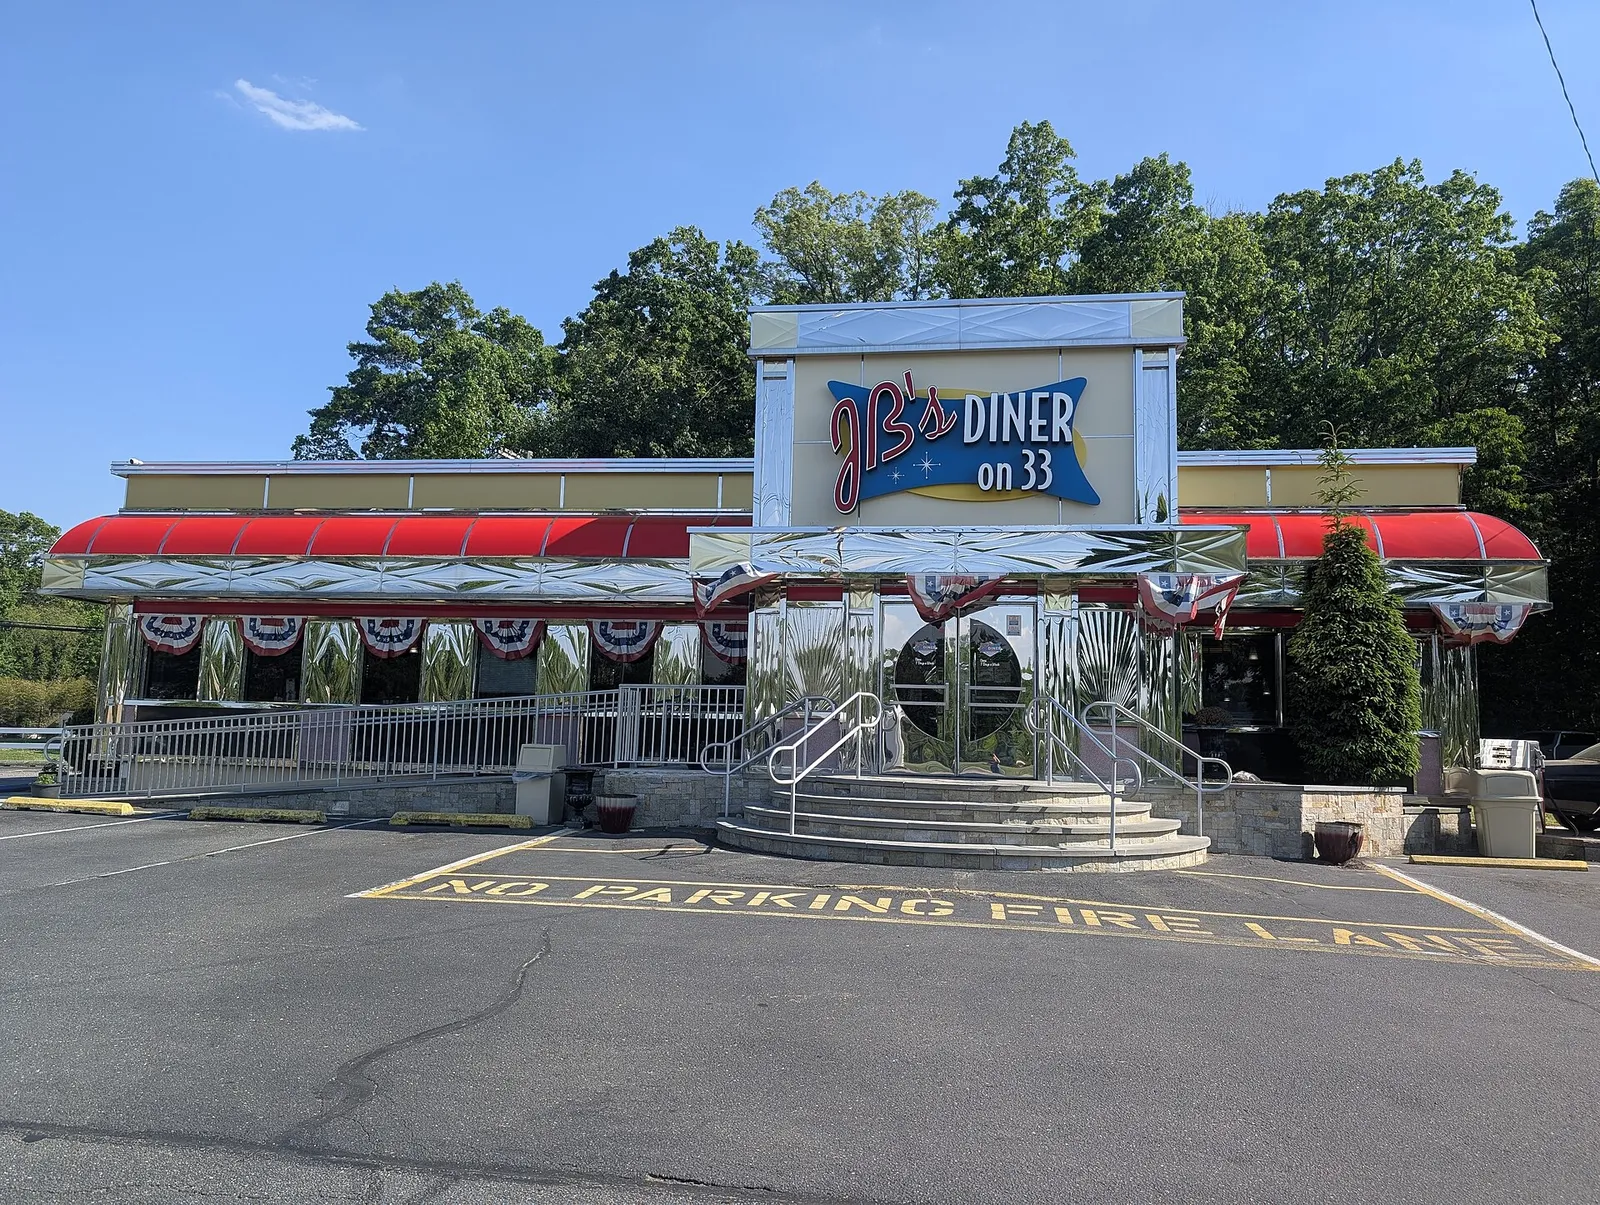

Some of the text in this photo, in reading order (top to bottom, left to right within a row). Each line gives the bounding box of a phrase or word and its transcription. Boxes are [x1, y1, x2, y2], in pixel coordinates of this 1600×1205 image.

[829, 368, 1074, 514] JB's DINER
[977, 449, 1052, 491] on 33
[421, 879, 1546, 958] NO PARKING FIRE LANE
